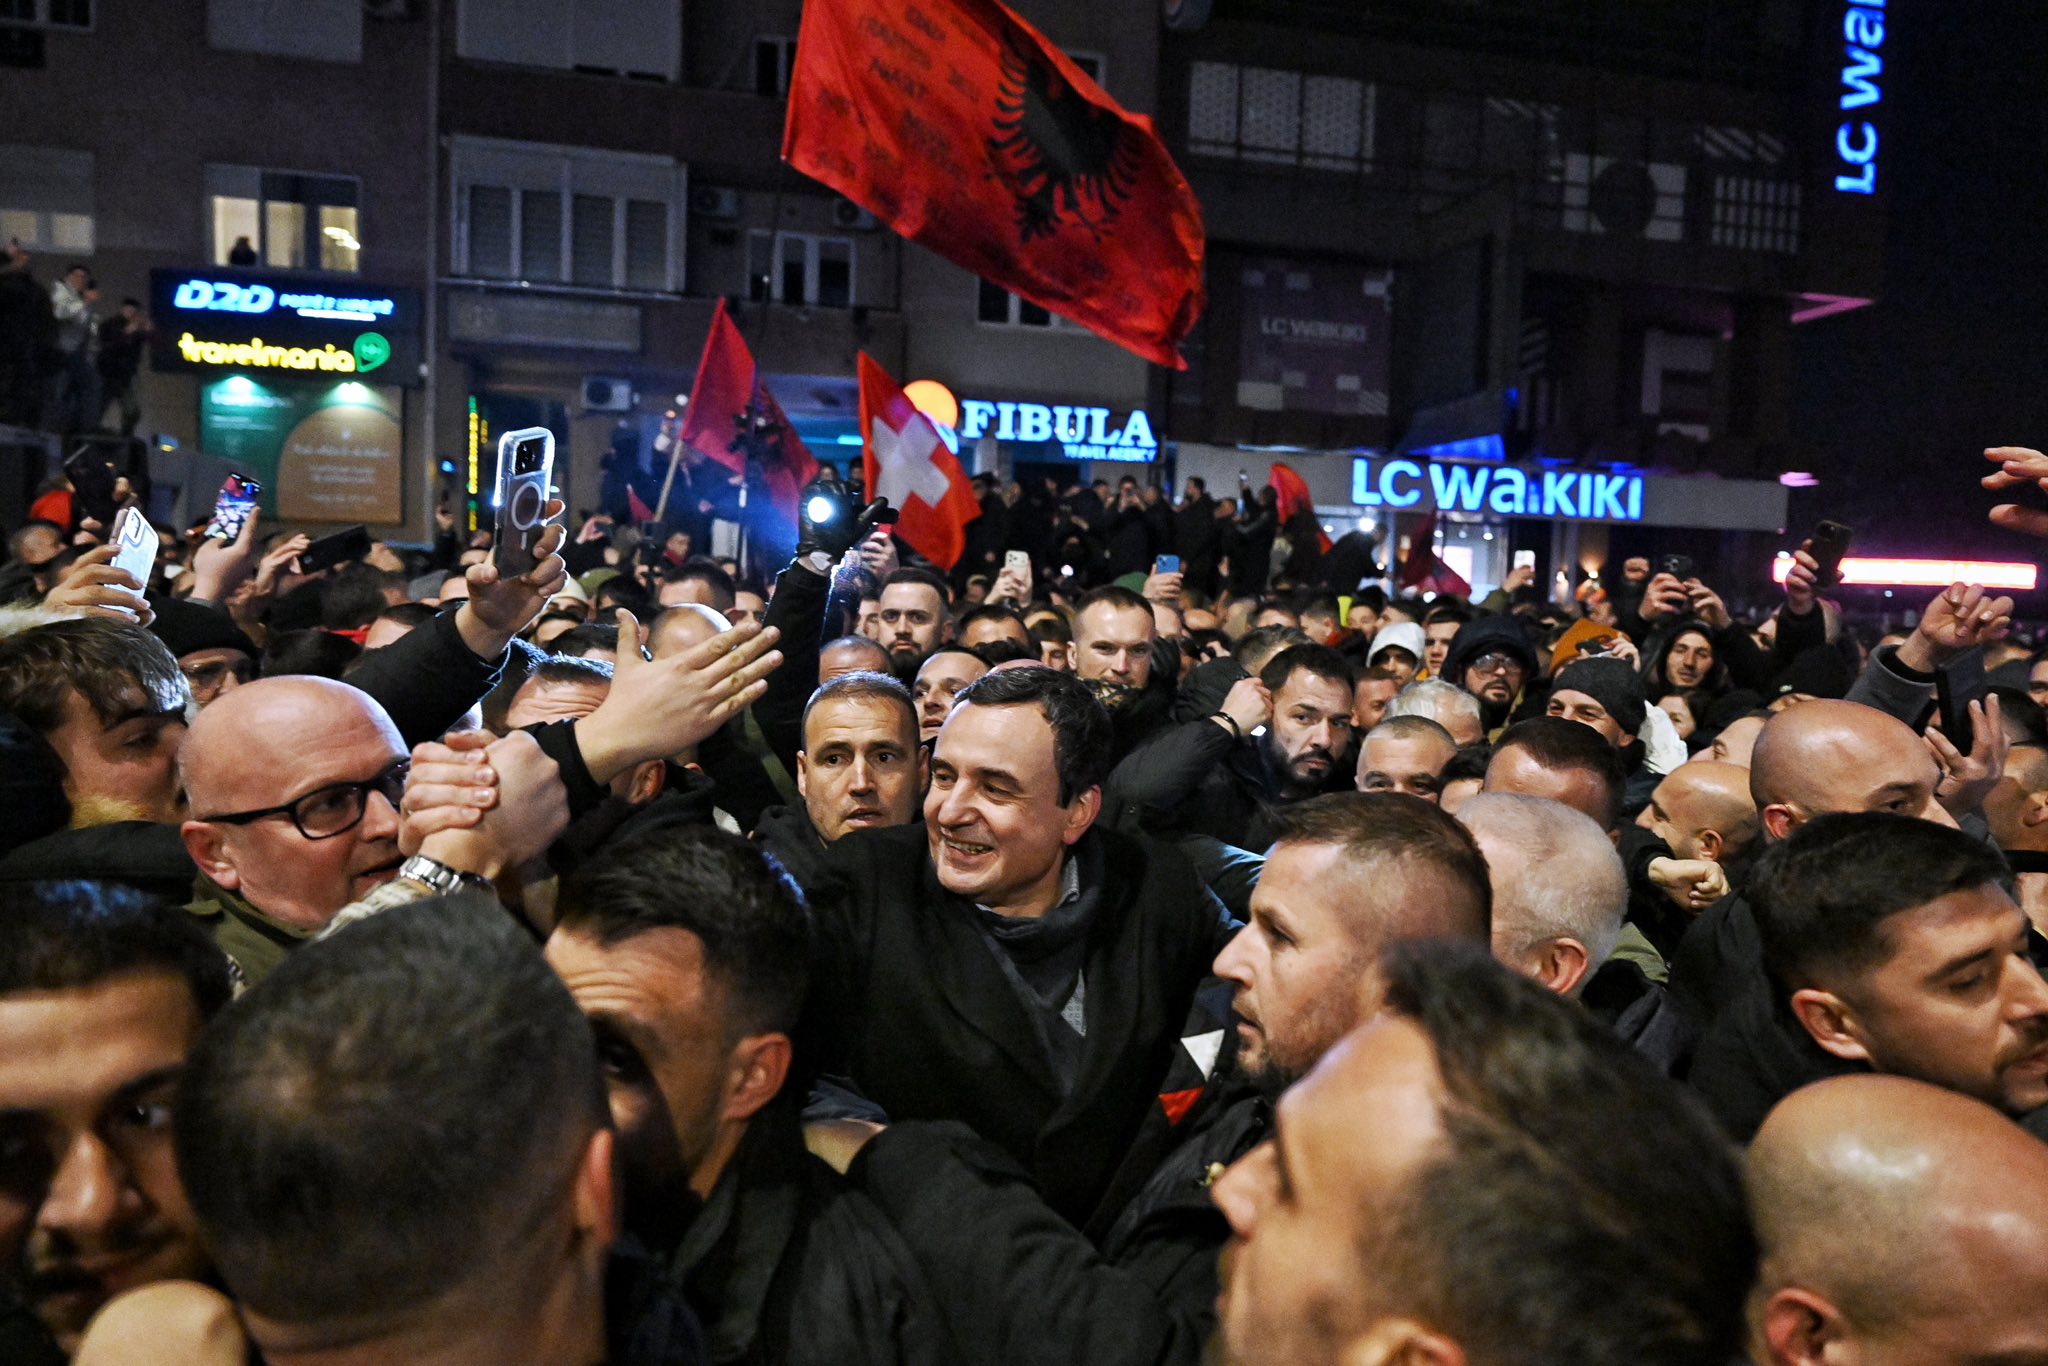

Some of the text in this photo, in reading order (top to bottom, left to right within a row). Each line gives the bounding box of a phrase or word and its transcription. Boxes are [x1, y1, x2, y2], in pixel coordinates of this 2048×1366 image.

[1835, 121, 1878, 194] LC
[174, 280, 275, 313] D2D
[177, 332, 355, 372] travelmania
[960, 399, 1157, 448] FIBULA
[1351, 457, 1422, 507] LC
